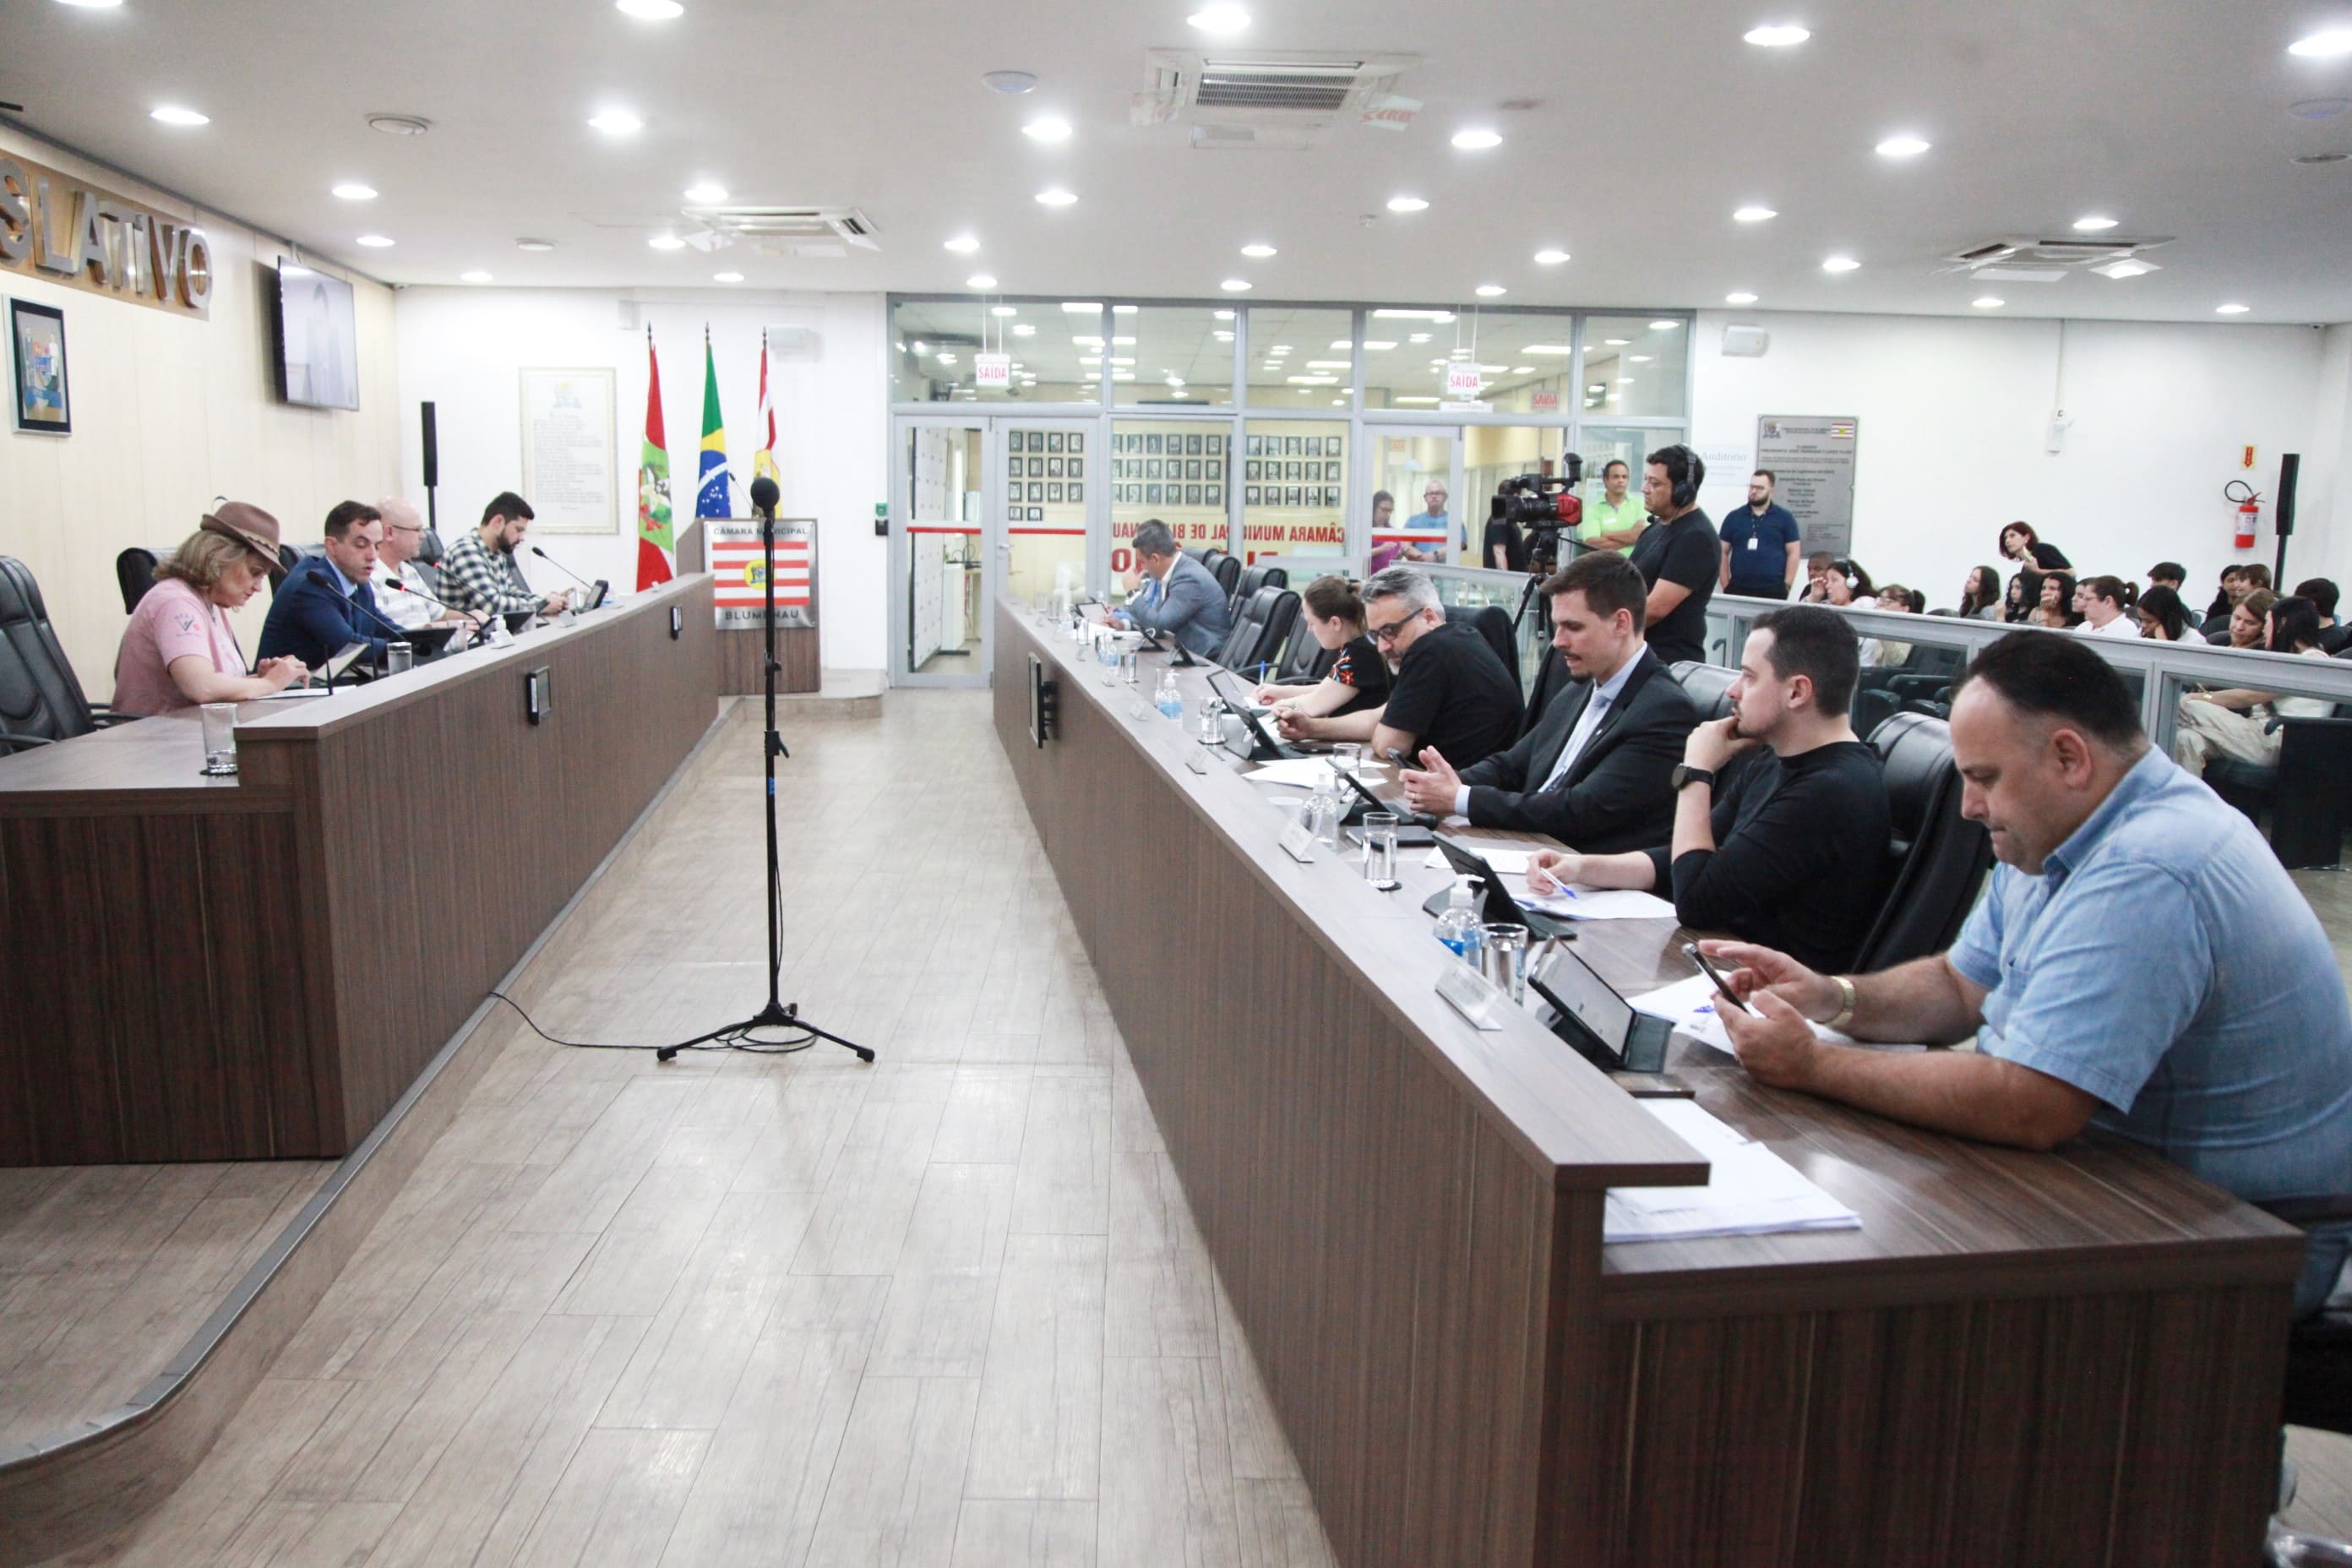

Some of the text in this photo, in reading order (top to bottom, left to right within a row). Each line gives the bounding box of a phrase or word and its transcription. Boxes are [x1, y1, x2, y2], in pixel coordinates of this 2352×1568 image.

[0, 158, 213, 311] SLATIVO
[978, 365, 1007, 378] SAÍDA
[1449, 373, 1478, 388] SAÍDA
[713, 525, 754, 536] CÂMARA
